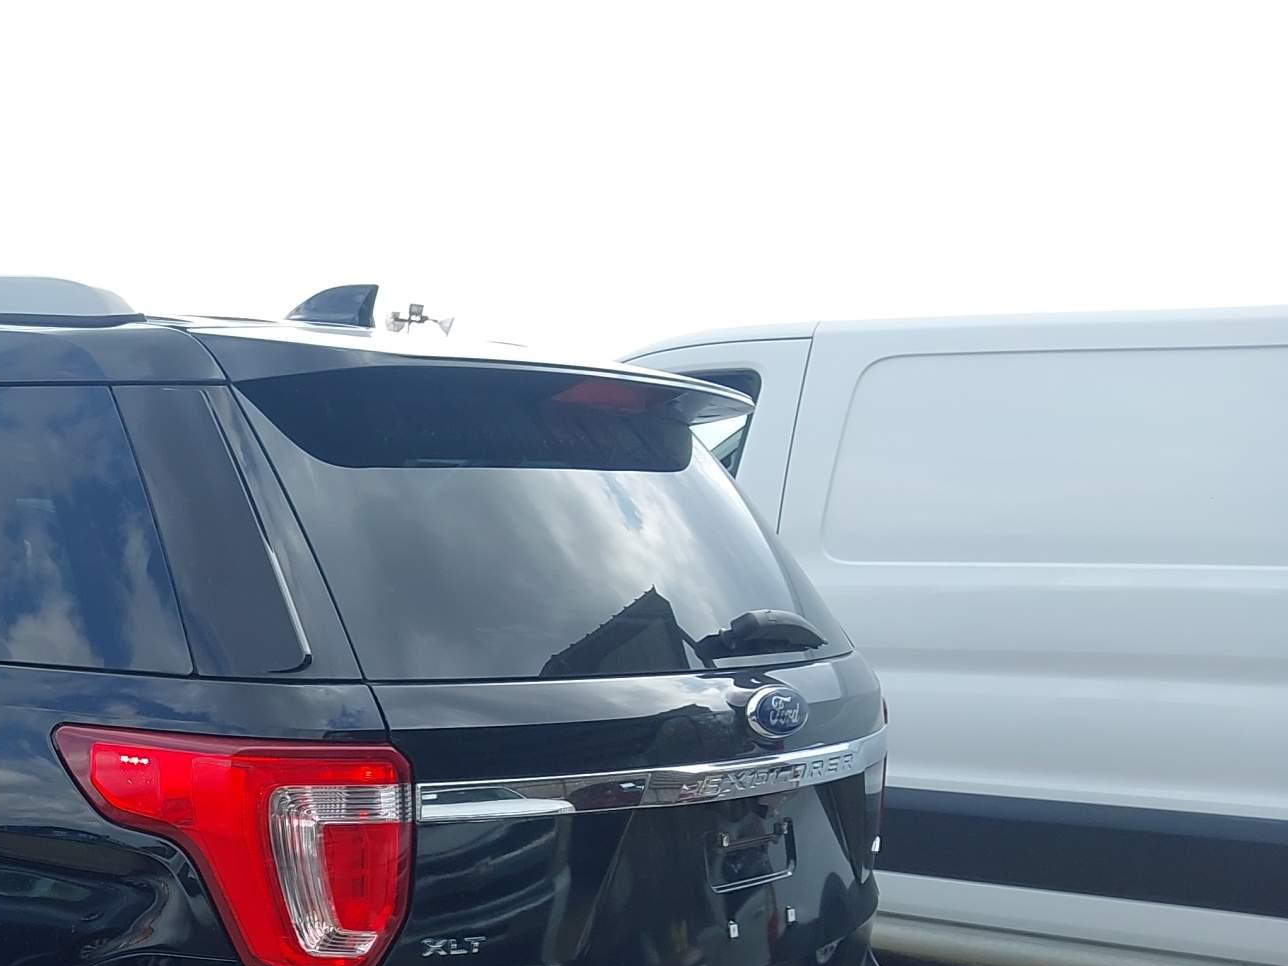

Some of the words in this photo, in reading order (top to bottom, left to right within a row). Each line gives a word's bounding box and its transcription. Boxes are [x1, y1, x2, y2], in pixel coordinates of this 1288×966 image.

[769, 696, 801, 726] Ford
[699, 752, 855, 797] EXPLORER
[421, 936, 487, 957] XLT
